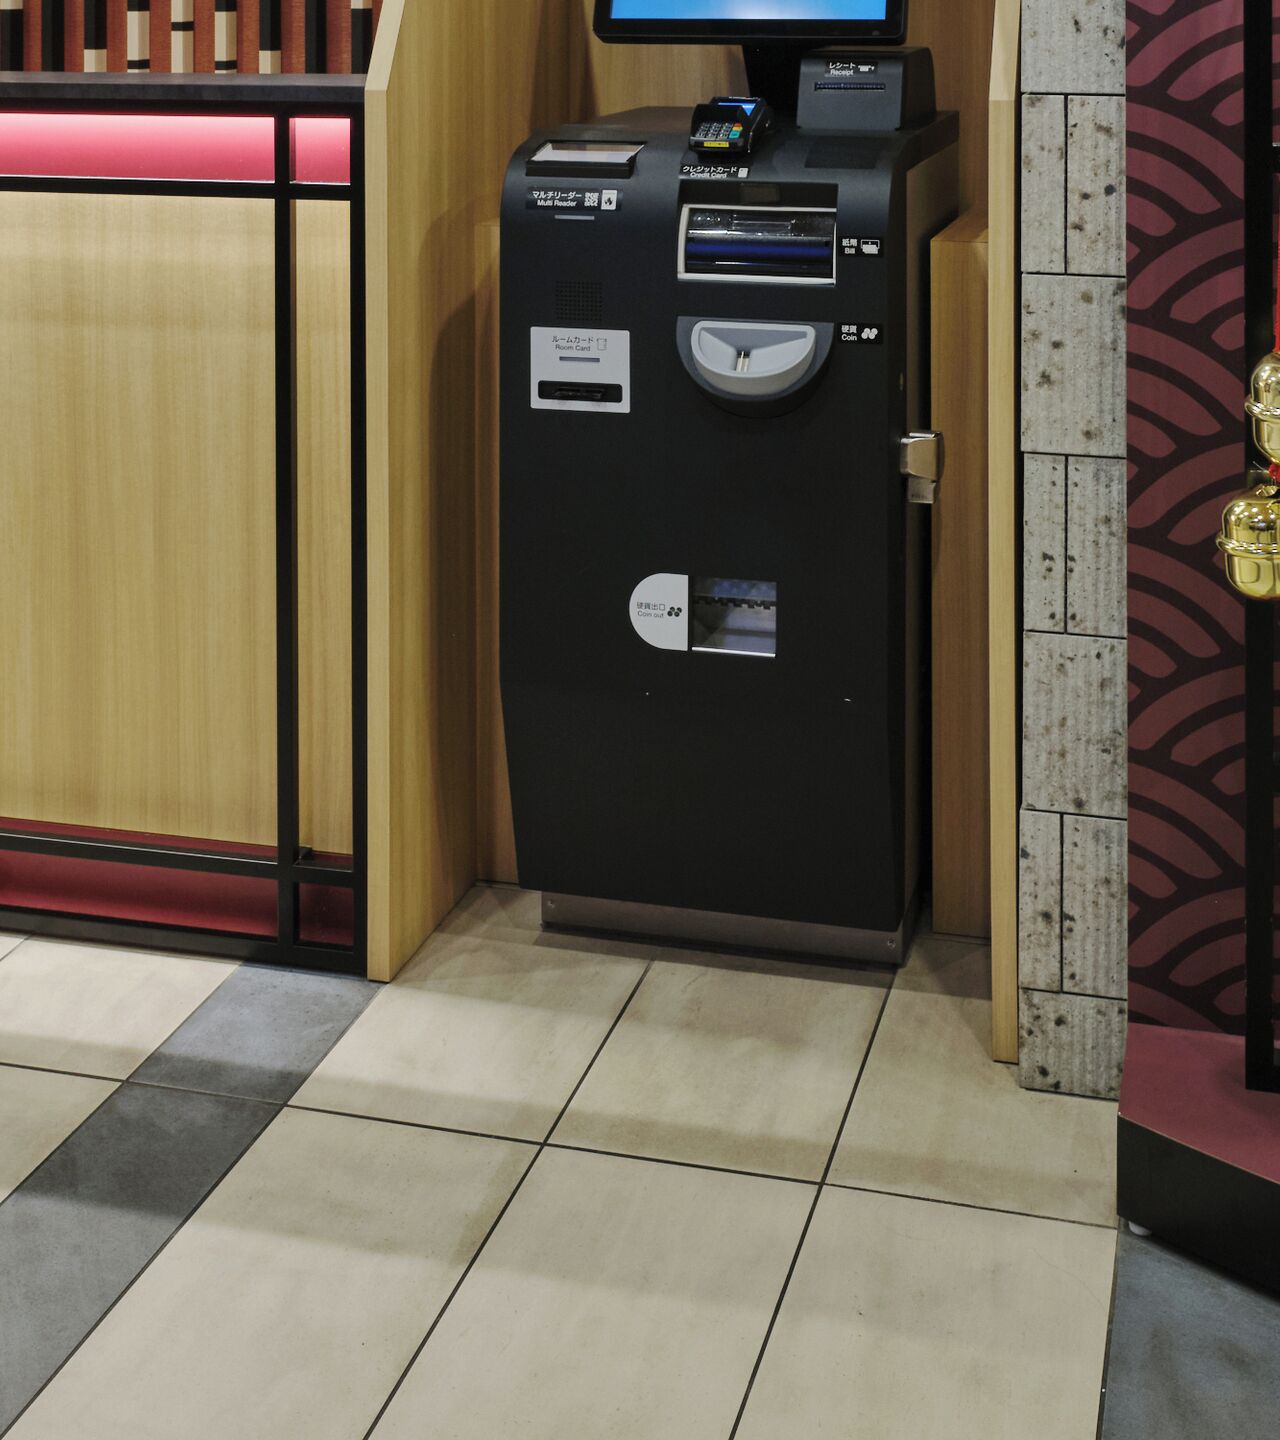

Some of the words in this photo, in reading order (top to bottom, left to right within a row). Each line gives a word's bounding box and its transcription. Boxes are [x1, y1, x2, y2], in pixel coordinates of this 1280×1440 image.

[830, 68, 854, 77] Receipt
[532, 191, 582, 199] マルチリーダー
[551, 335, 595, 344] ルームカード
[841, 333, 858, 341] Coin
[555, 343, 574, 351] Room
[575, 344, 591, 352] Card
